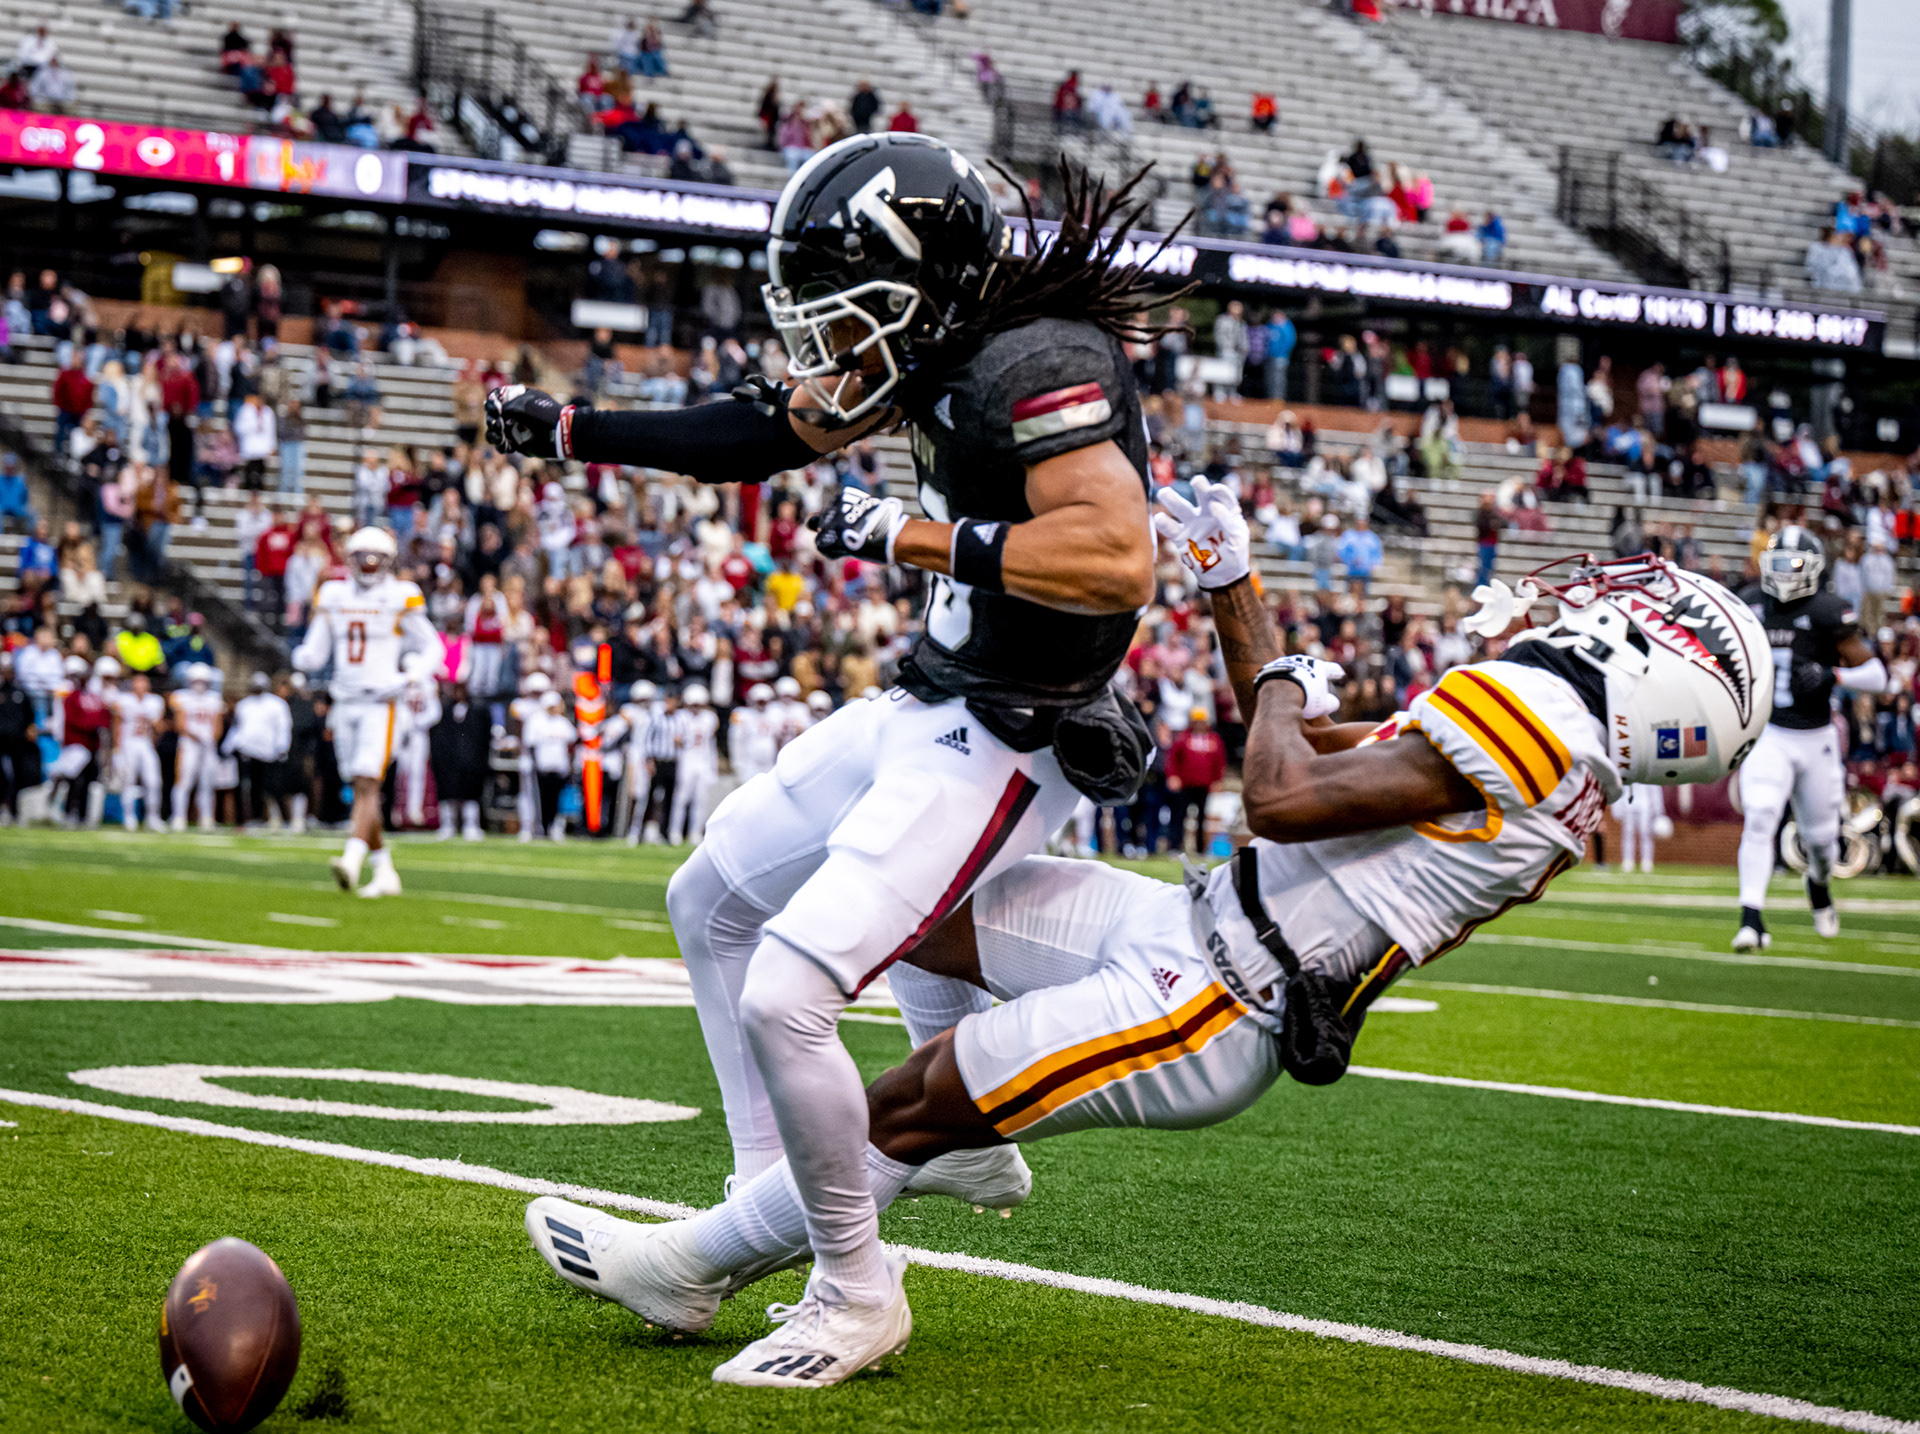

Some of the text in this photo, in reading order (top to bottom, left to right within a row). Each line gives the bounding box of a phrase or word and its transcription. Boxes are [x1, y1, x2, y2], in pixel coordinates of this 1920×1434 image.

[74, 124, 105, 170] 2
[215, 149, 234, 181] 1
[354, 153, 383, 194] 0
[1542, 285, 1578, 316] AL
[347, 620, 367, 665] 0
[935, 735, 972, 756] adidas
[1150, 967, 1171, 1001] adidas
